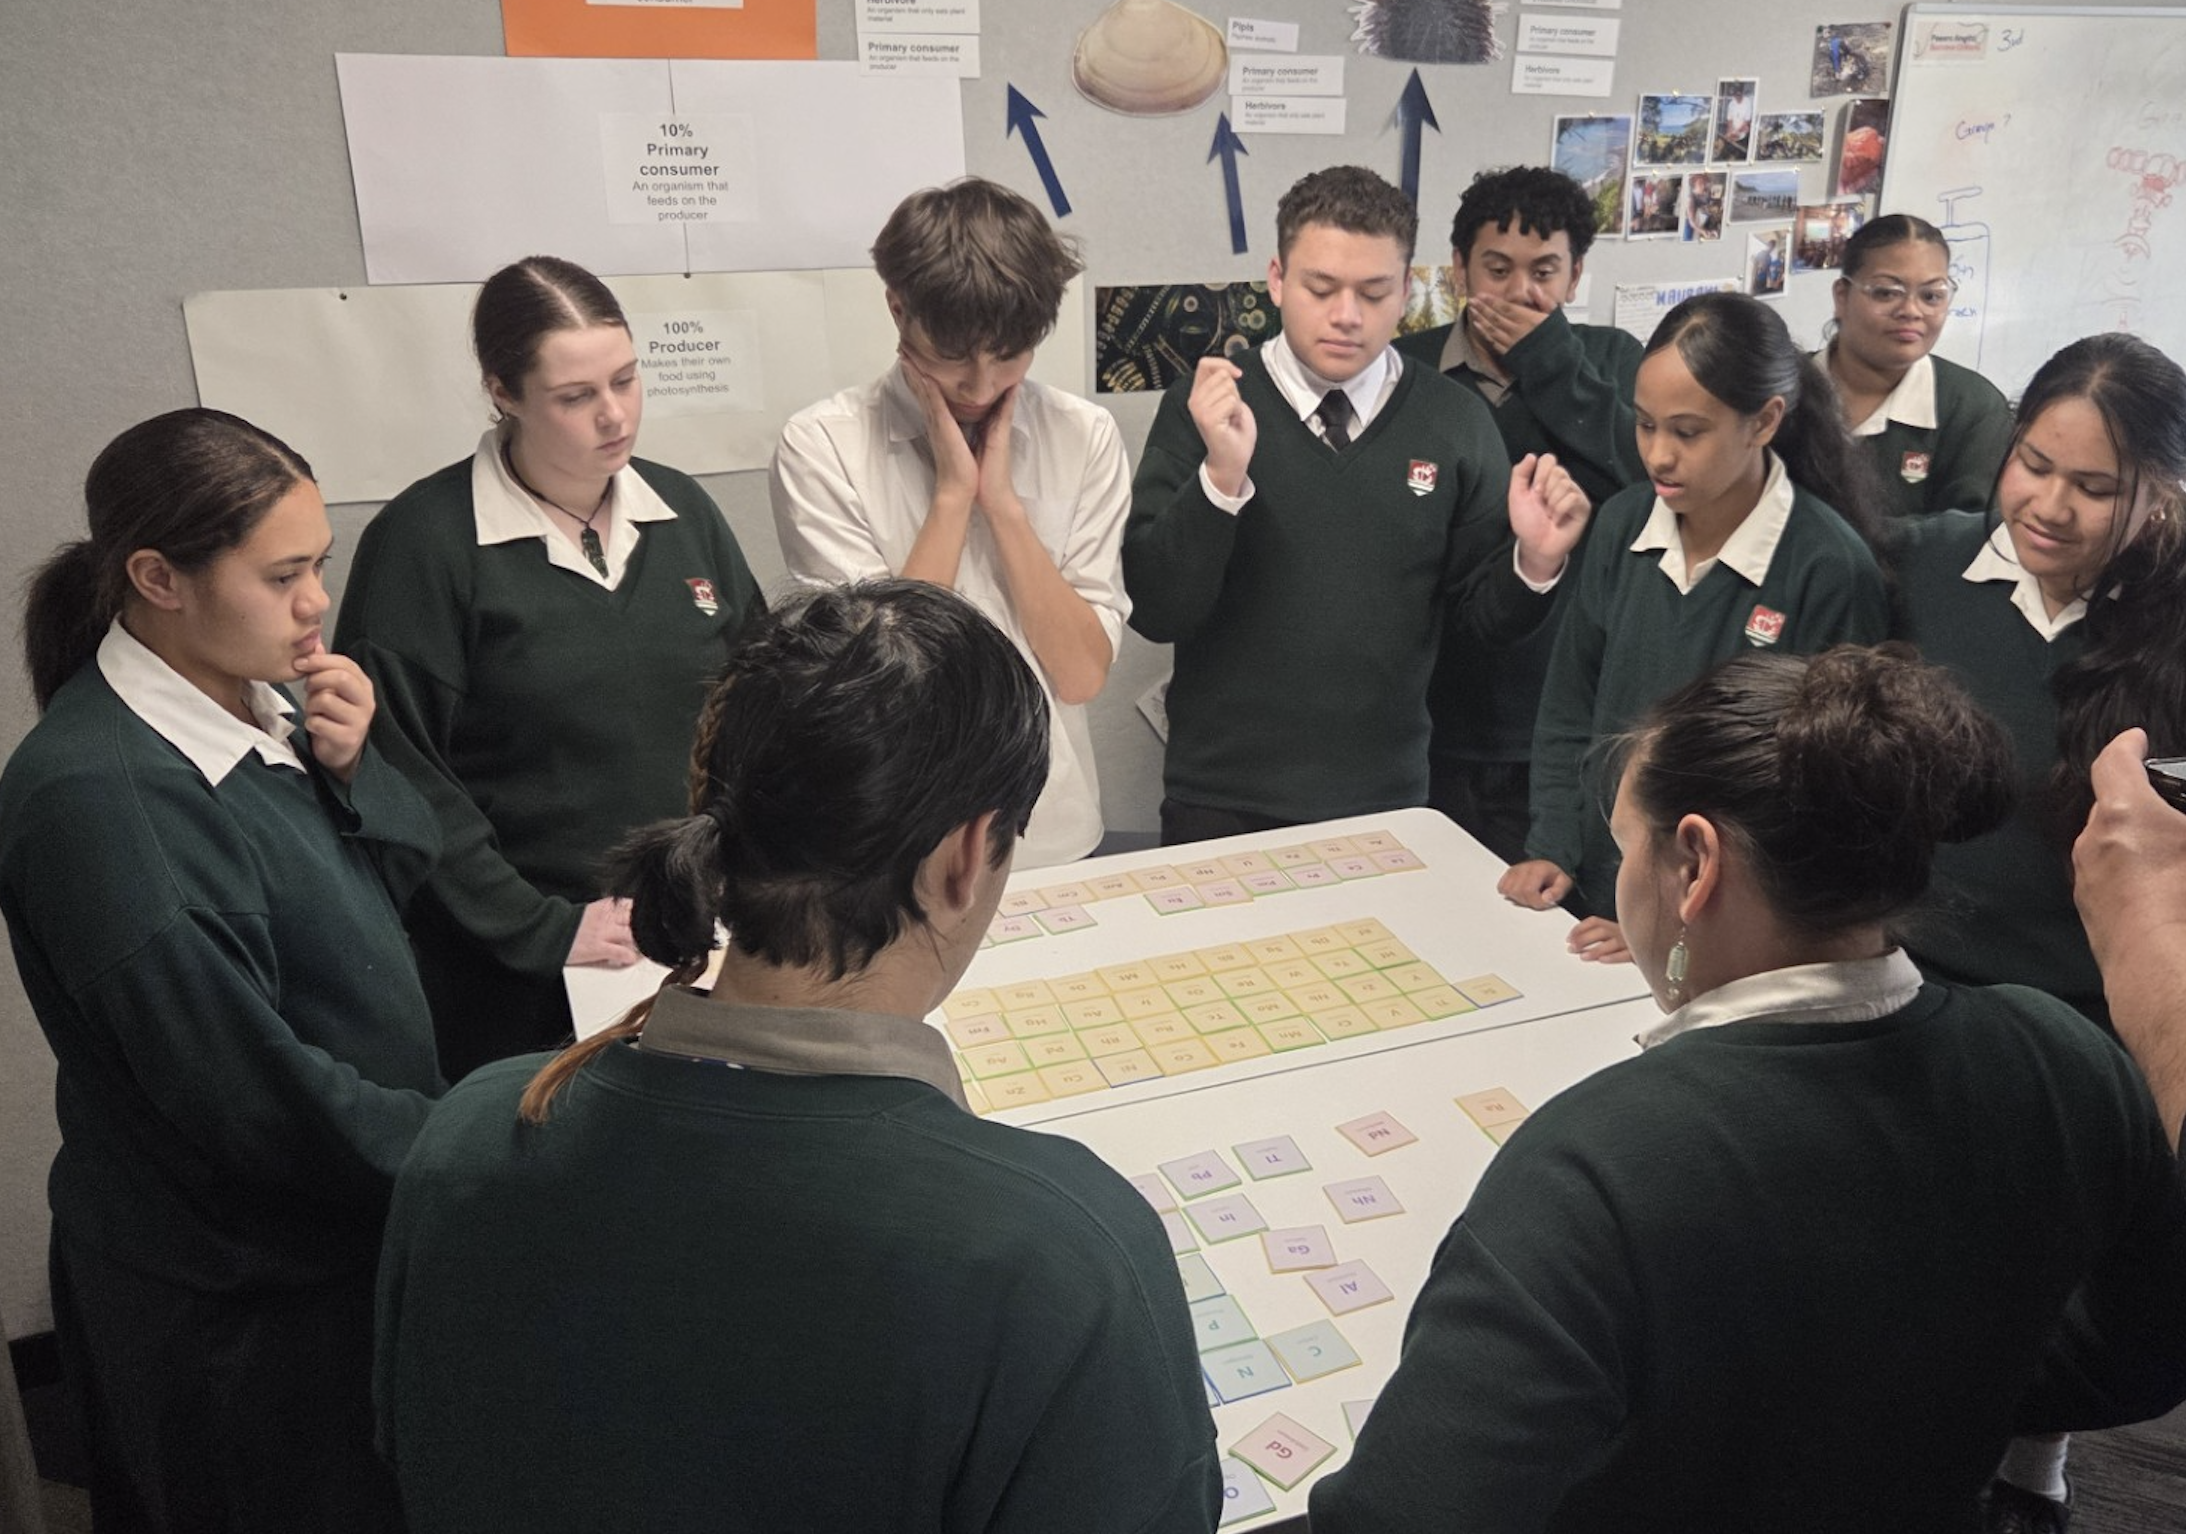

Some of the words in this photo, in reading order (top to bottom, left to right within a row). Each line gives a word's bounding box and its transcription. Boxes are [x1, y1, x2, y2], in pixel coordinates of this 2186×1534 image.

[1529, 25, 1558, 36] Primary
[868, 42, 907, 54] Primary
[910, 44, 960, 53] consumer
[1242, 66, 1275, 77] Primary
[1277, 68, 1318, 76] consumer
[1245, 102, 1286, 110] Herbivore
[660, 123, 693, 137] 10%
[647, 143, 709, 159] Primary
[640, 165, 720, 176] consumer
[632, 181, 648, 191] An
[652, 181, 704, 193] organism
[707, 181, 729, 191] that
[647, 195, 679, 206] feeds
[682, 197, 696, 206] on
[698, 196, 717, 206] the
[658, 211, 708, 221] producer
[663, 321, 704, 335] 100%
[649, 340, 721, 353] Producer
[641, 358, 678, 369] Makes
[681, 356, 704, 366] their
[708, 356, 731, 365] own
[658, 371, 683, 381] food
[686, 371, 716, 381] using
[646, 383, 730, 397] photosynthesis
[1063, 1074, 1083, 1083] Cu
[1006, 1086, 1026, 1095] Zn
[1368, 1128, 1391, 1140] Nd
[1191, 1170, 1212, 1180] Pb
[1352, 1194, 1377, 1205] Nh
[1287, 1244, 1310, 1255] Ga
[1339, 1280, 1358, 1295] Al
[1208, 1319, 1220, 1331] P
[1308, 1345, 1322, 1357] C
[1236, 1366, 1254, 1379] N
[1265, 1440, 1293, 1459] Gd
